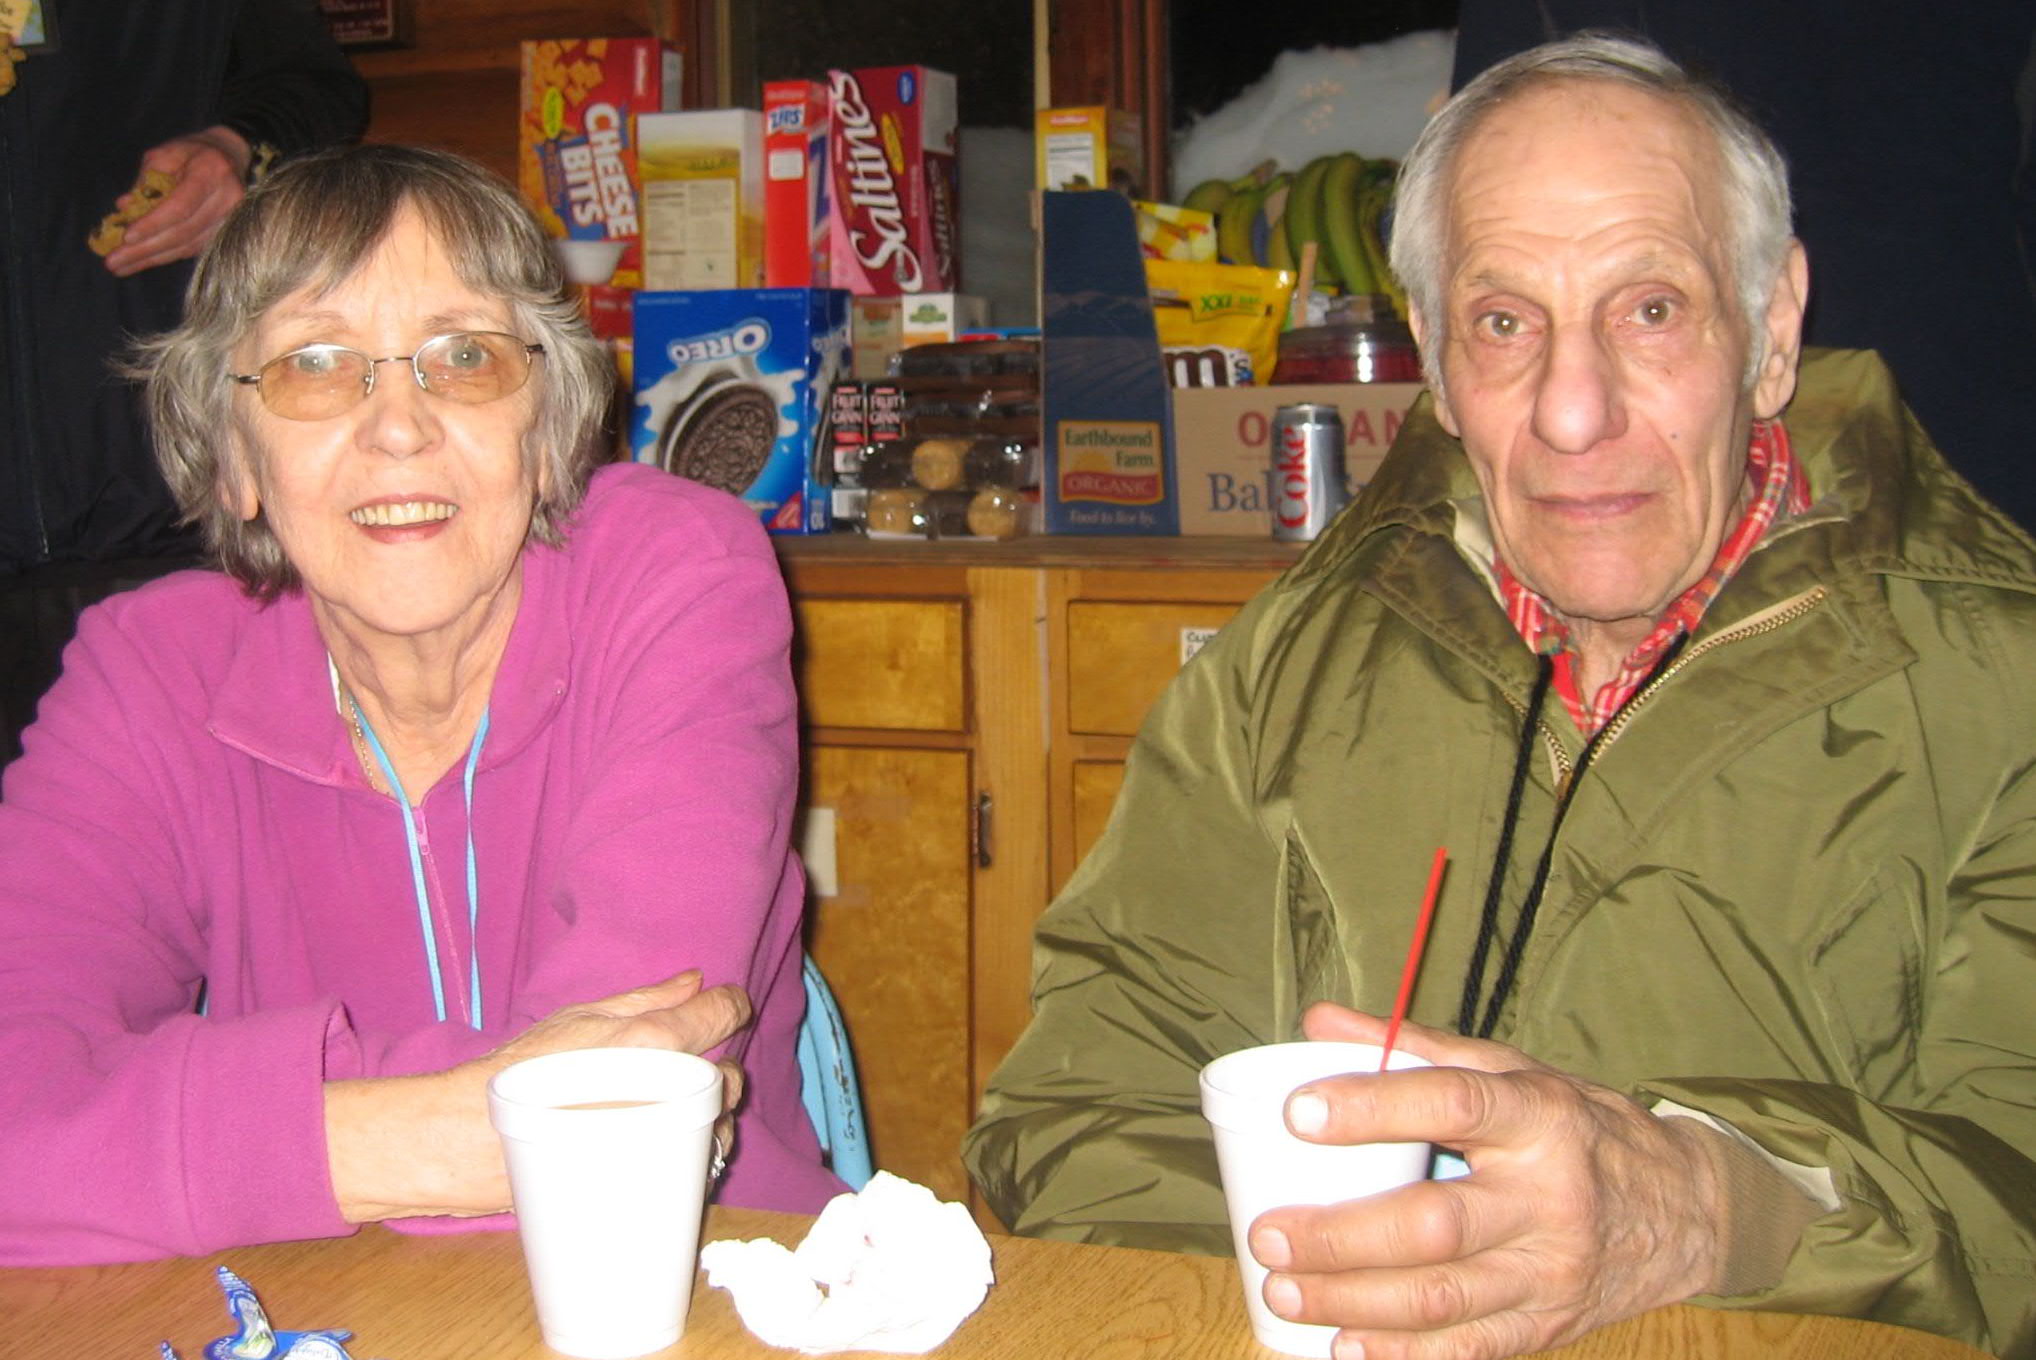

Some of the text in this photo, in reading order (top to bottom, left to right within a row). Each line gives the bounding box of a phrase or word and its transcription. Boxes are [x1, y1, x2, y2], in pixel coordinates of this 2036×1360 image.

[560, 145, 602, 229] BITS
[584, 102, 640, 239] CHEESE
[829, 69, 924, 293] Saltines
[670, 321, 770, 363] OREO
[1065, 429, 1153, 448] Earthbound
[1115, 451, 1154, 468] Farm
[1066, 475, 1155, 497] ORGANIC
[1277, 427, 1309, 529] Coke
